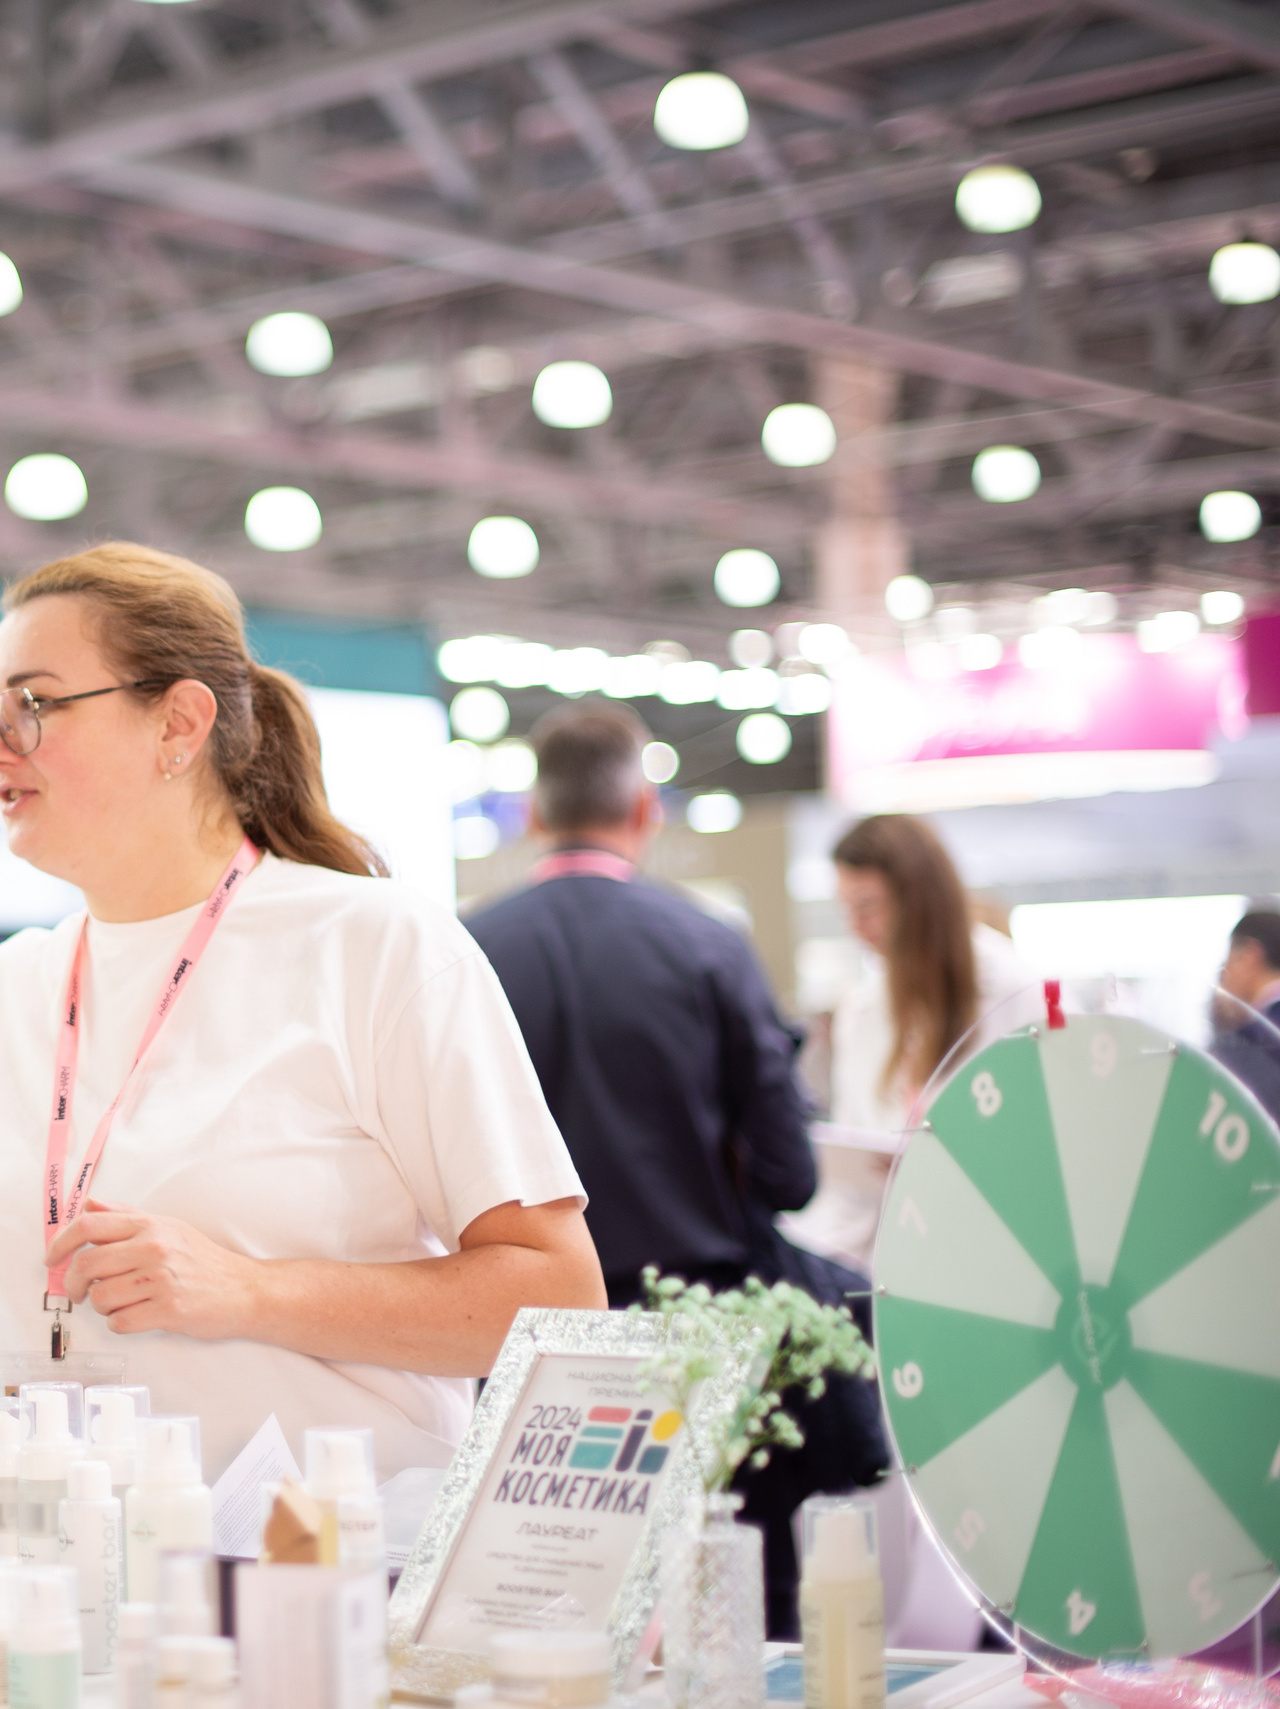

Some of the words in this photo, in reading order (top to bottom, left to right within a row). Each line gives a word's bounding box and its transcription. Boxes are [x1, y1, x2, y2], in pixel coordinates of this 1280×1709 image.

[207, 868, 243, 919] interCHARM
[157, 957, 193, 1016] interCHARM
[54, 1066, 71, 1121] interCHARM
[971, 1070, 1003, 1118] 8
[1199, 1089, 1251, 1162] 10
[47, 1163, 60, 1226] interCHARM
[524, 1404, 583, 1431] 2024
[509, 1431, 572, 1467] МОЯ
[493, 1469, 651, 1516] КОСМЕТИКА
[516, 1521, 600, 1541] ЛАУРЕАТ
[1066, 1588, 1097, 1637] 4
